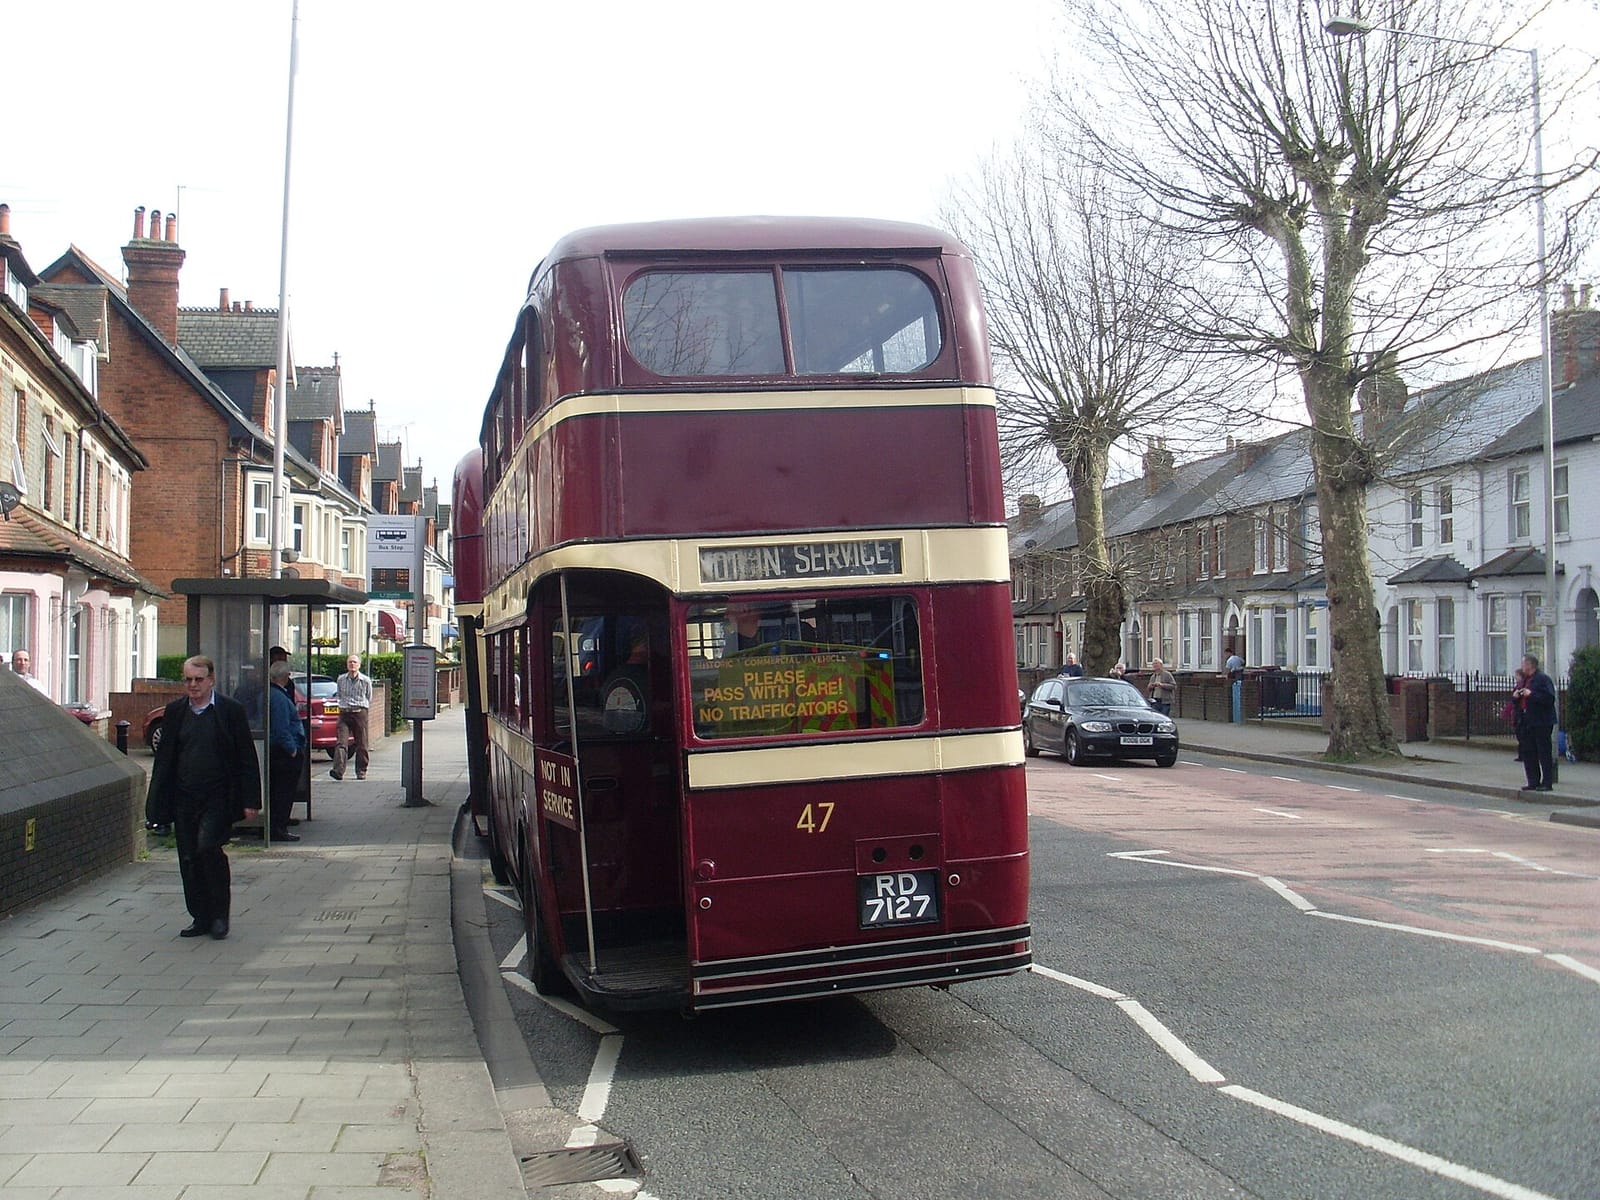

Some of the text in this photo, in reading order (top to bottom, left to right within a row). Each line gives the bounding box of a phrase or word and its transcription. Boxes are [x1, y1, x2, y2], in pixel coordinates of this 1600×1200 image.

[795, 541, 889, 573] SERVICE
[744, 656, 801, 667] COMMERCIAL
[811, 654, 847, 664] VEHICLE
[703, 677, 843, 702] PASS WITH CARE!
[744, 670, 806, 687] PLEASE
[699, 700, 849, 723] NO TRAFFICATORS
[541, 759, 570, 787] NOT IN
[543, 789, 573, 819] SERVICE
[796, 802, 835, 833] 47
[876, 873, 918, 897] RD
[866, 895, 931, 922] 7127
